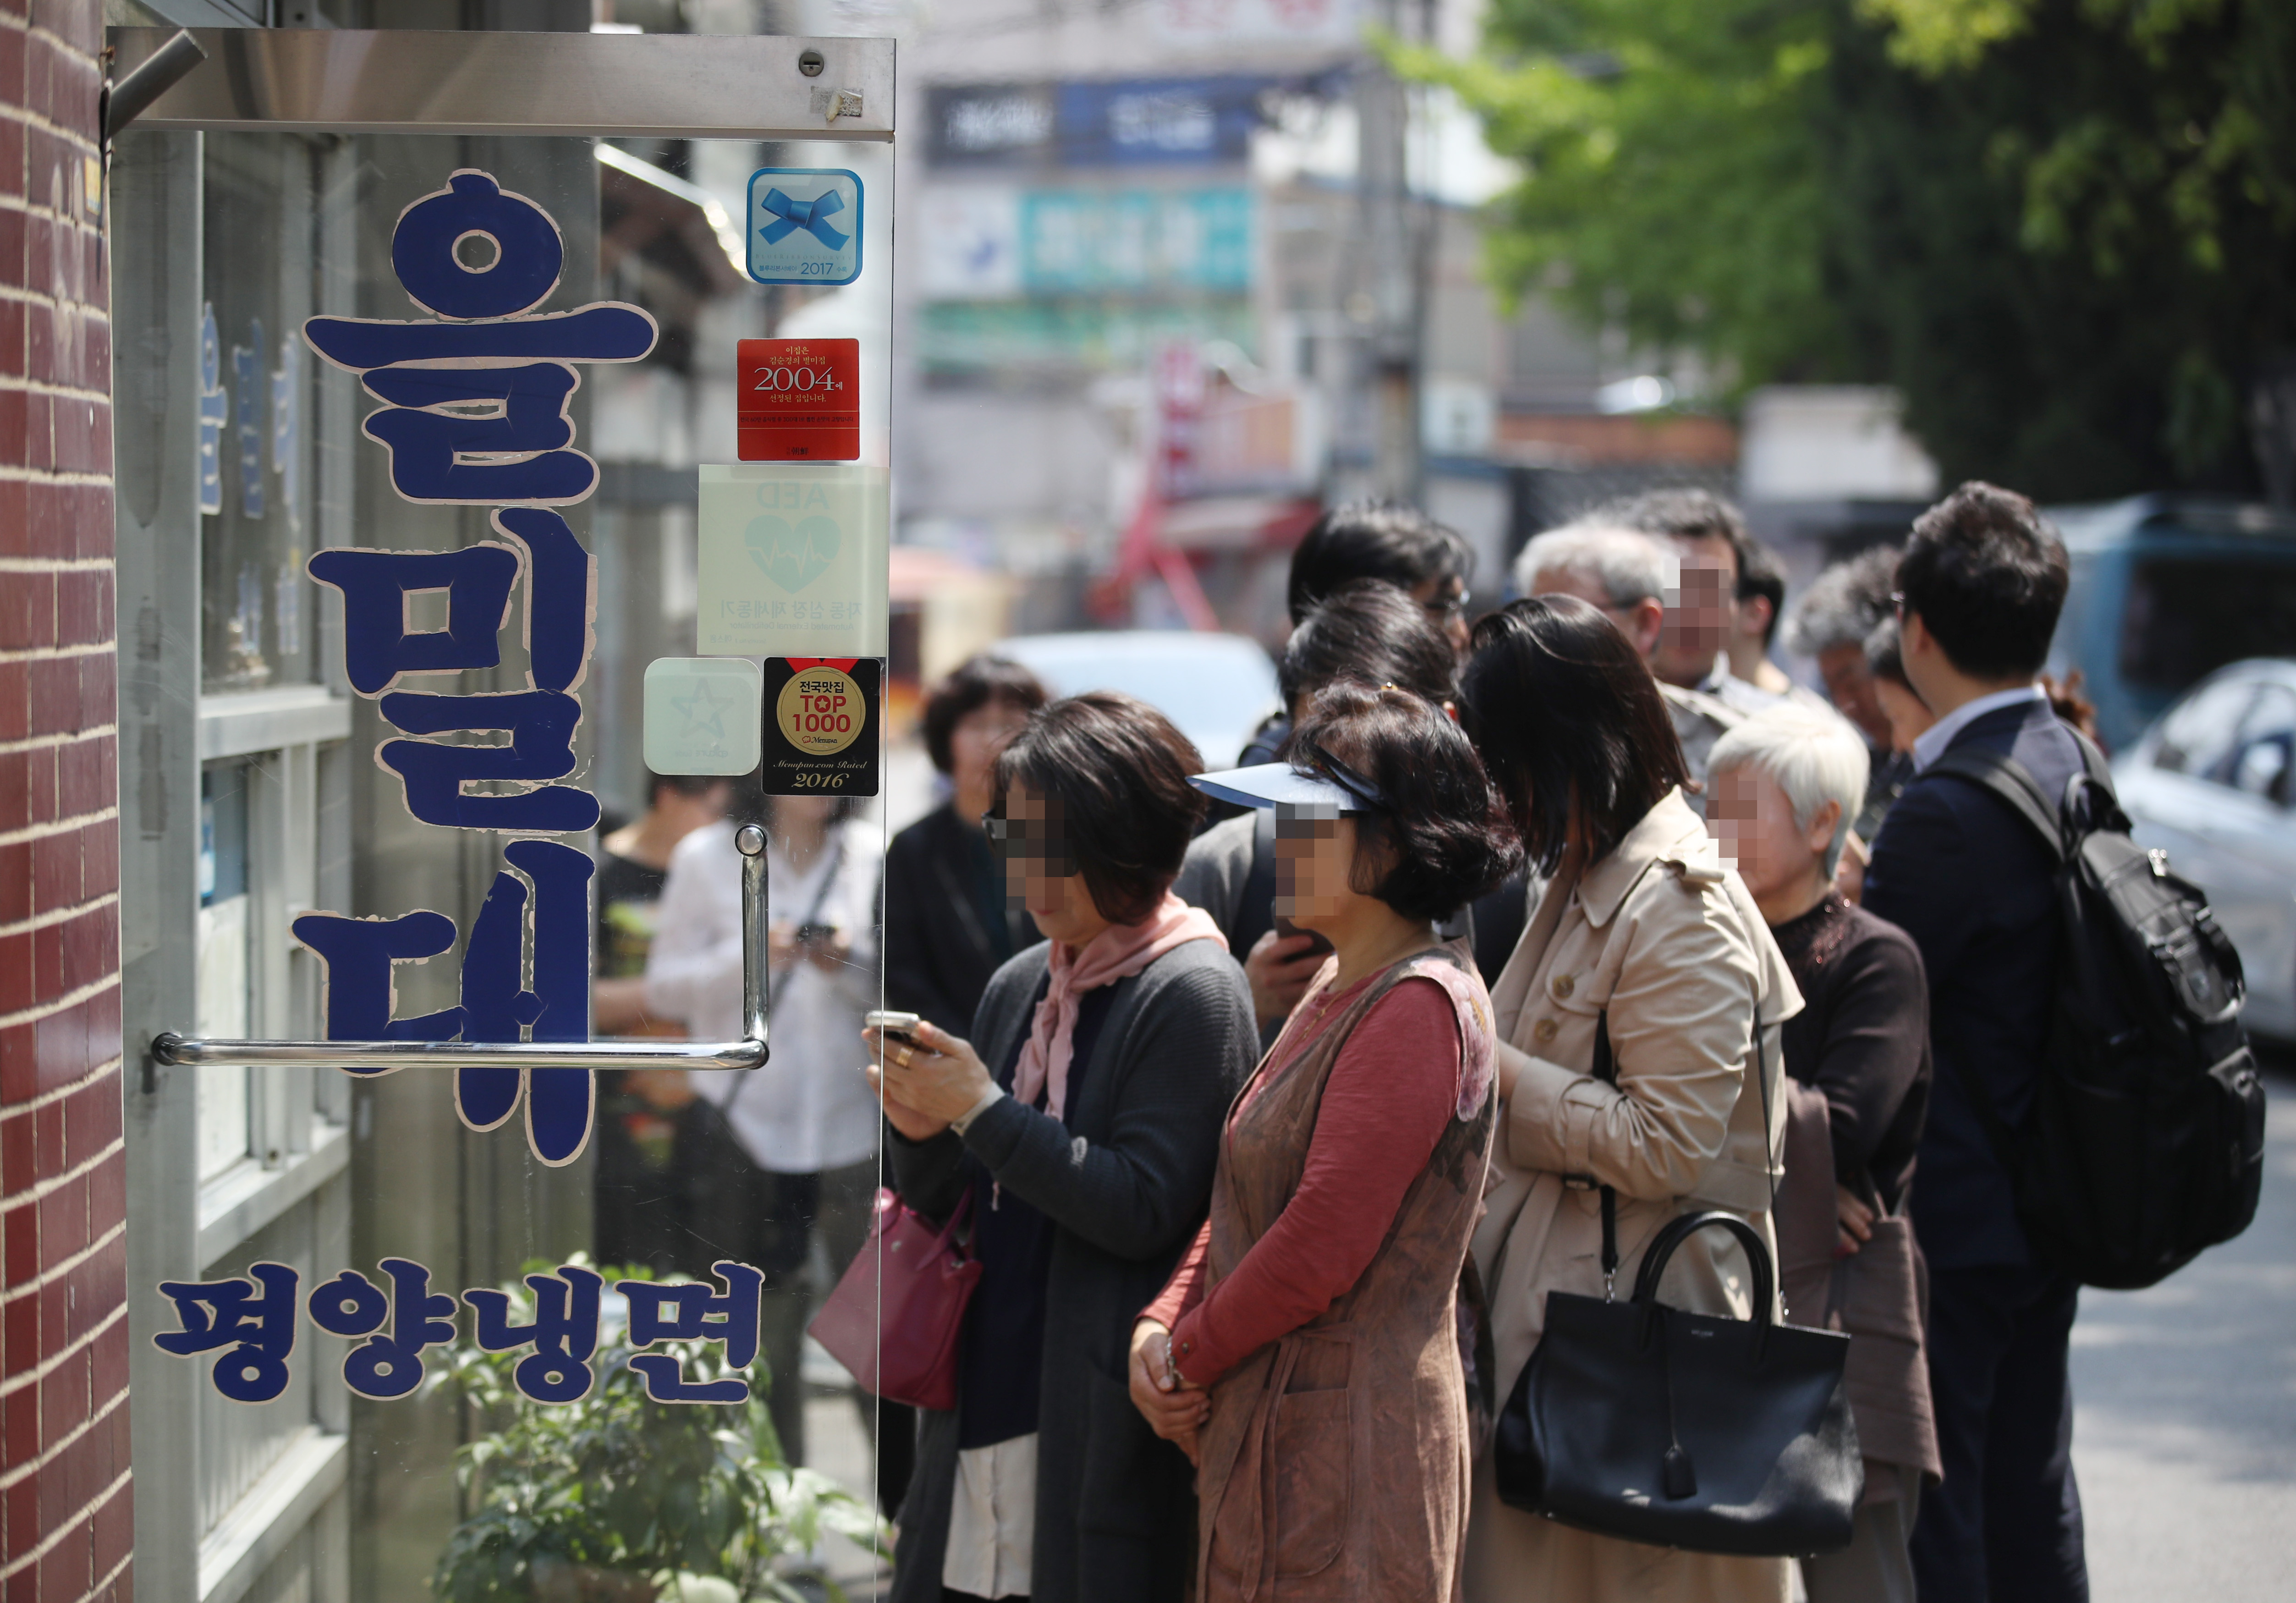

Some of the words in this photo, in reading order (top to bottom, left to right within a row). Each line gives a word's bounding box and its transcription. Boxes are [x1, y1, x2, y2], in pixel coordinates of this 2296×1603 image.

[800, 262, 834, 275] 2017
[785, 346, 809, 355] 이집은
[769, 356, 800, 365] 김순경의
[769, 394, 792, 403] 선정된
[795, 394, 827, 403] 집입니다.
[290, 168, 659, 1168] 을밀대
[799, 681, 844, 693] 전국맛집
[800, 695, 846, 713] TOP
[792, 714, 851, 733] 1000
[773, 759, 834, 770] Menupan.com
[837, 760, 868, 769] Rated
[791, 773, 850, 788] 2016
[154, 1256, 765, 1405] 평양냉면
